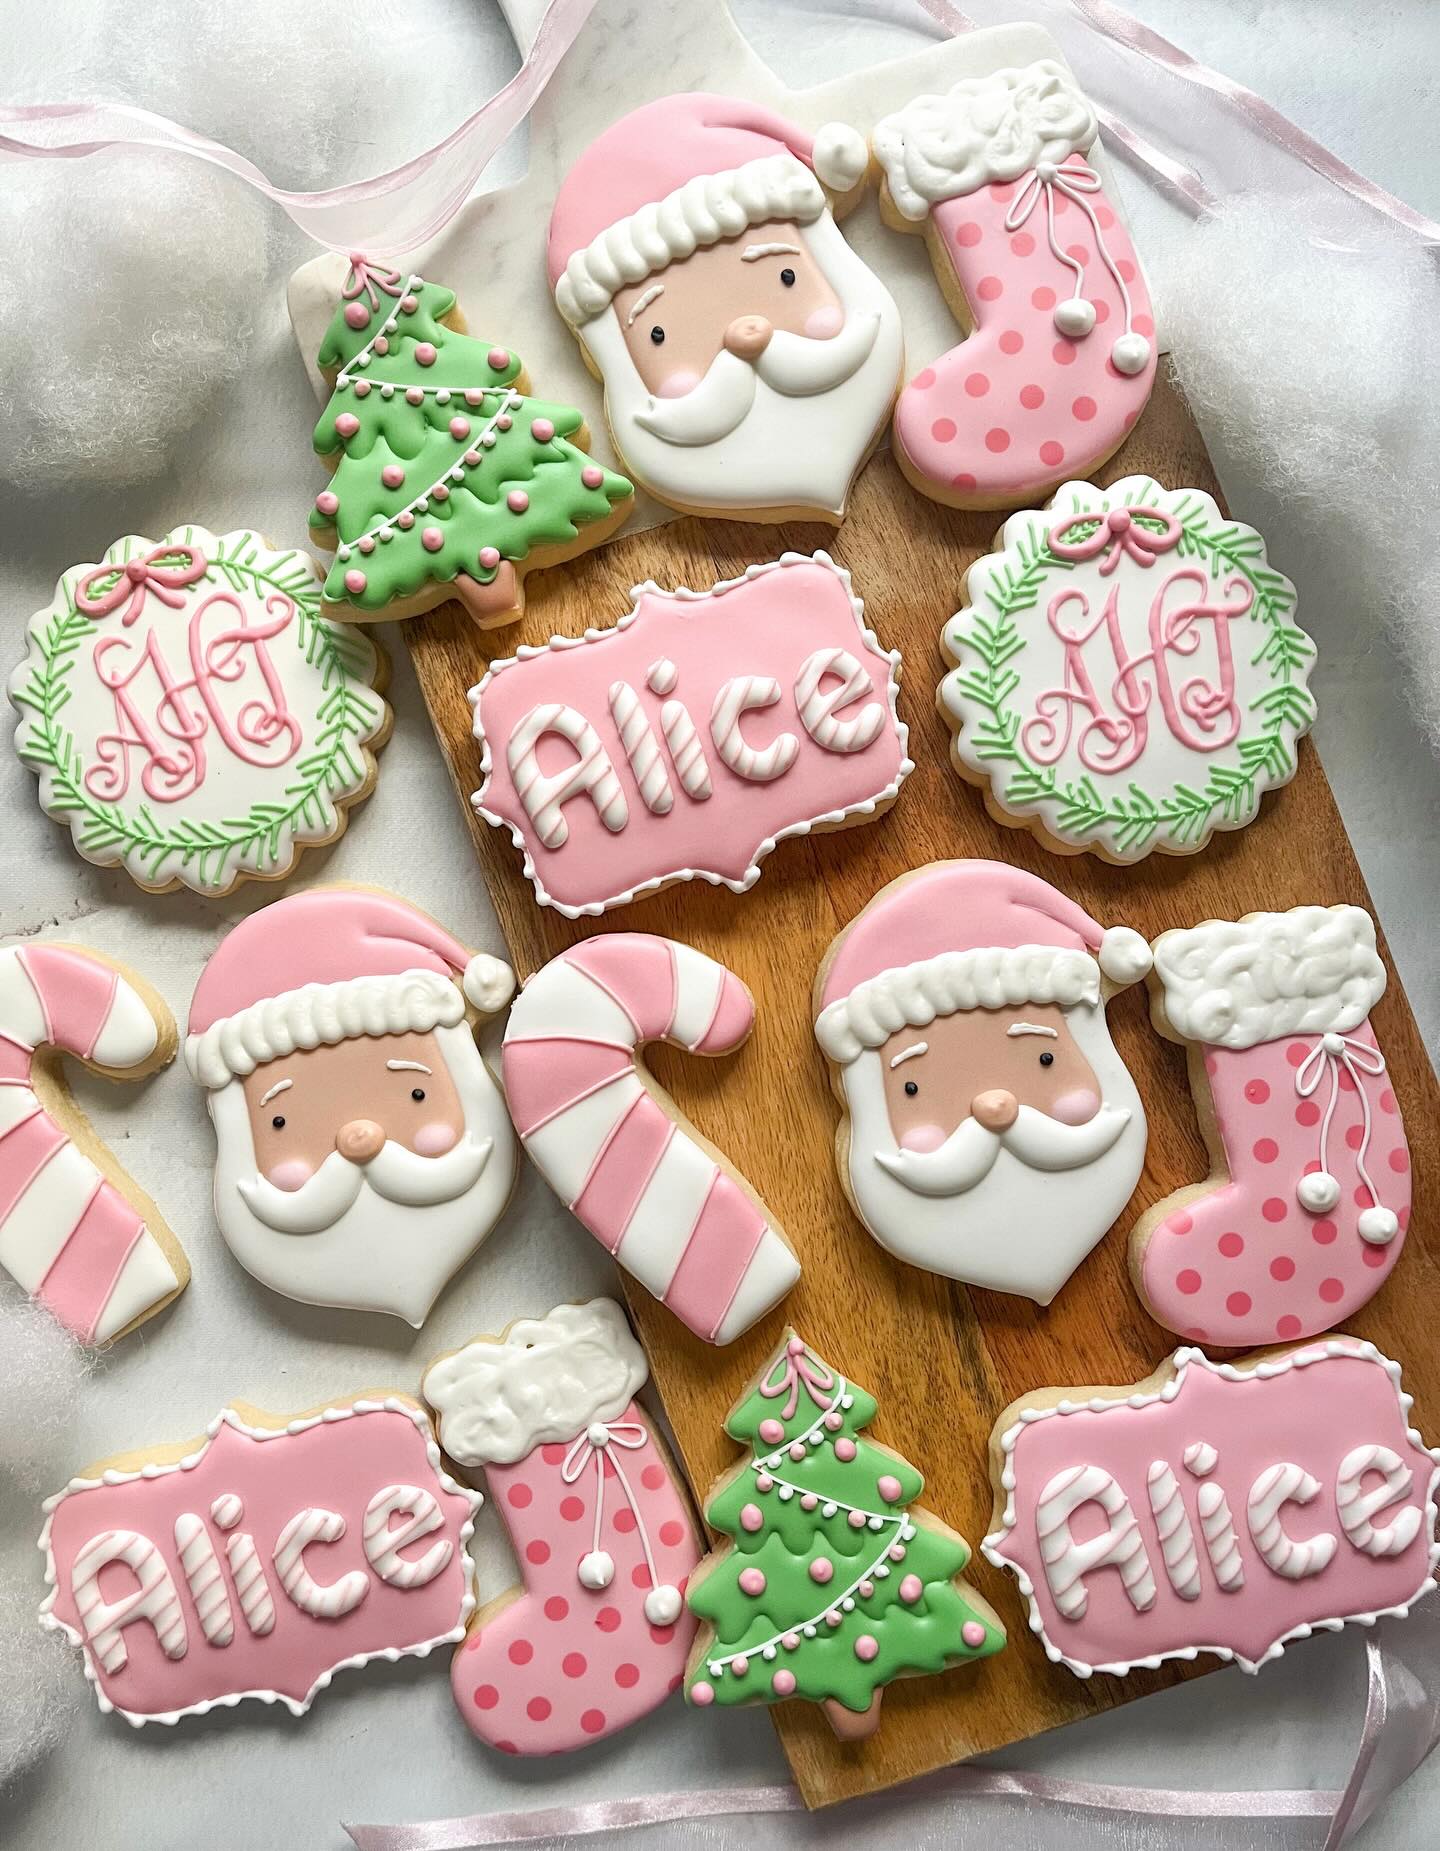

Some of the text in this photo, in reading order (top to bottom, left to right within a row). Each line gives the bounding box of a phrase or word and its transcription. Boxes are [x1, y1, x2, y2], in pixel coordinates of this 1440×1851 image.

[507, 647, 886, 849] Alice
[71, 1484, 454, 1675] Alice
[1036, 1441, 1423, 1620] Alice
